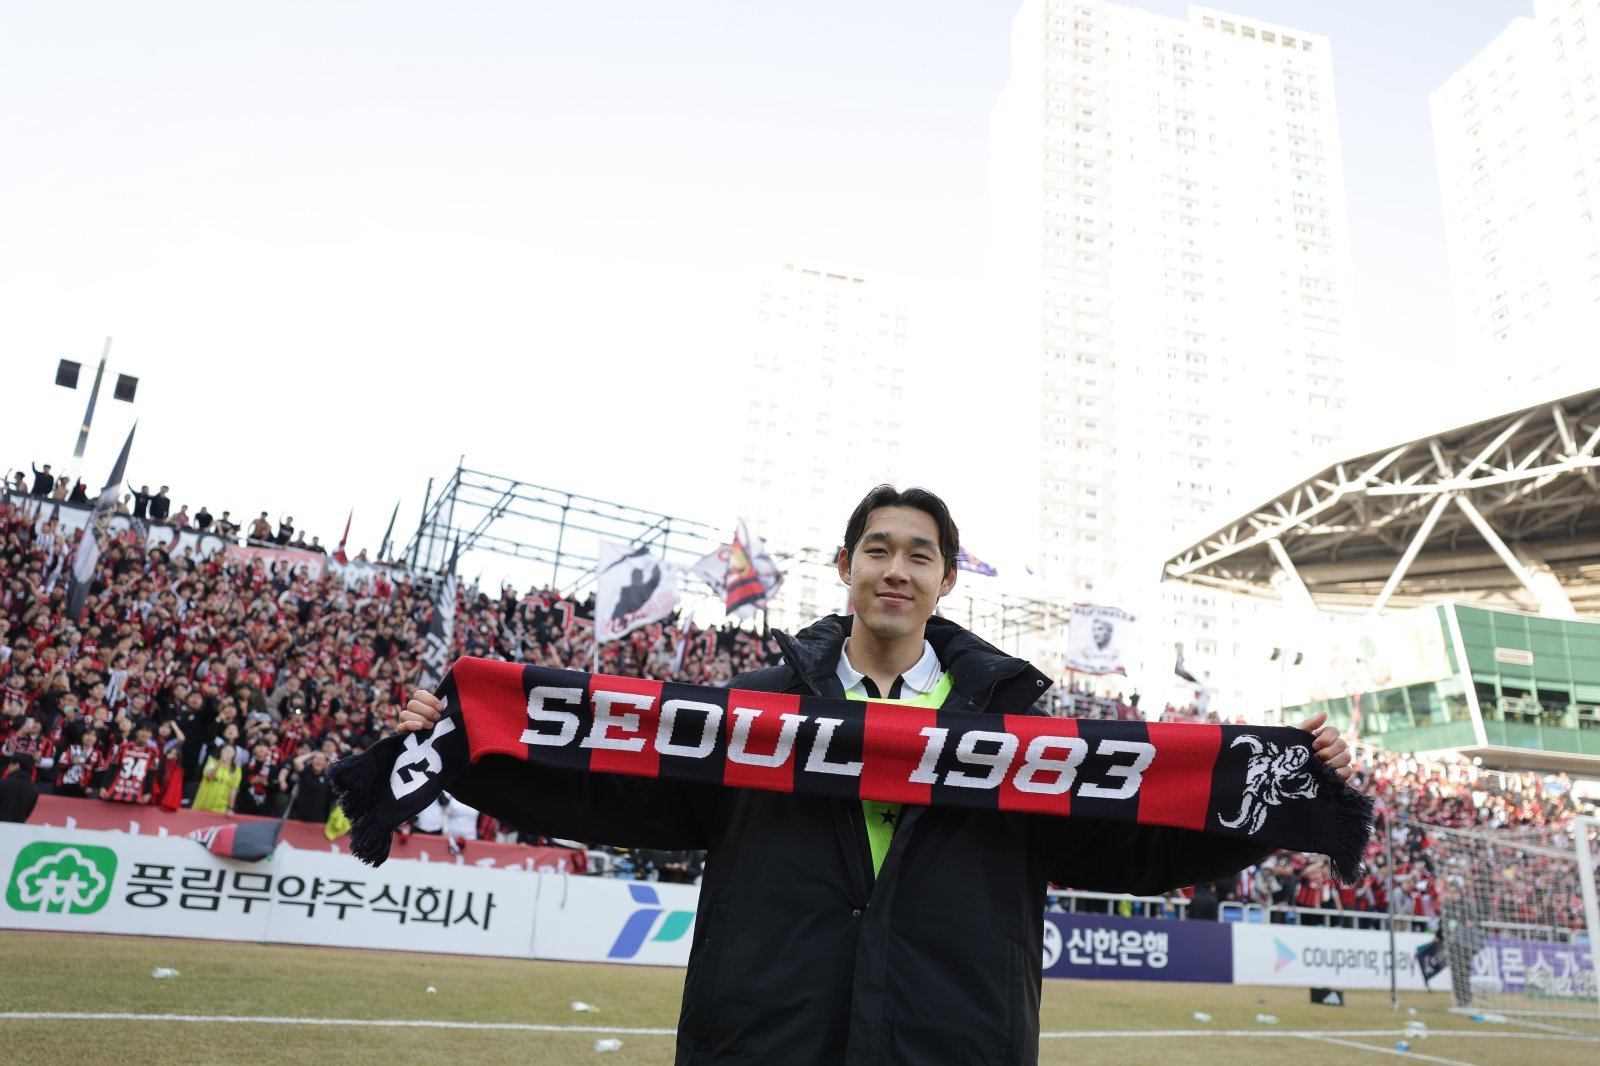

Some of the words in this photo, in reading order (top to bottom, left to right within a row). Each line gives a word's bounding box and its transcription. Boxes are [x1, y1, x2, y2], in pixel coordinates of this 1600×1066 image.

[519, 685, 865, 777] SEOUL
[908, 726, 1156, 800] 1983
[120, 756, 147, 781] 34
[125, 862, 497, 930] 풍림무약주식회사
[1066, 927, 1169, 968] 신한은행
[1302, 946, 1380, 976] coupang
[1382, 948, 1417, 978] pay
